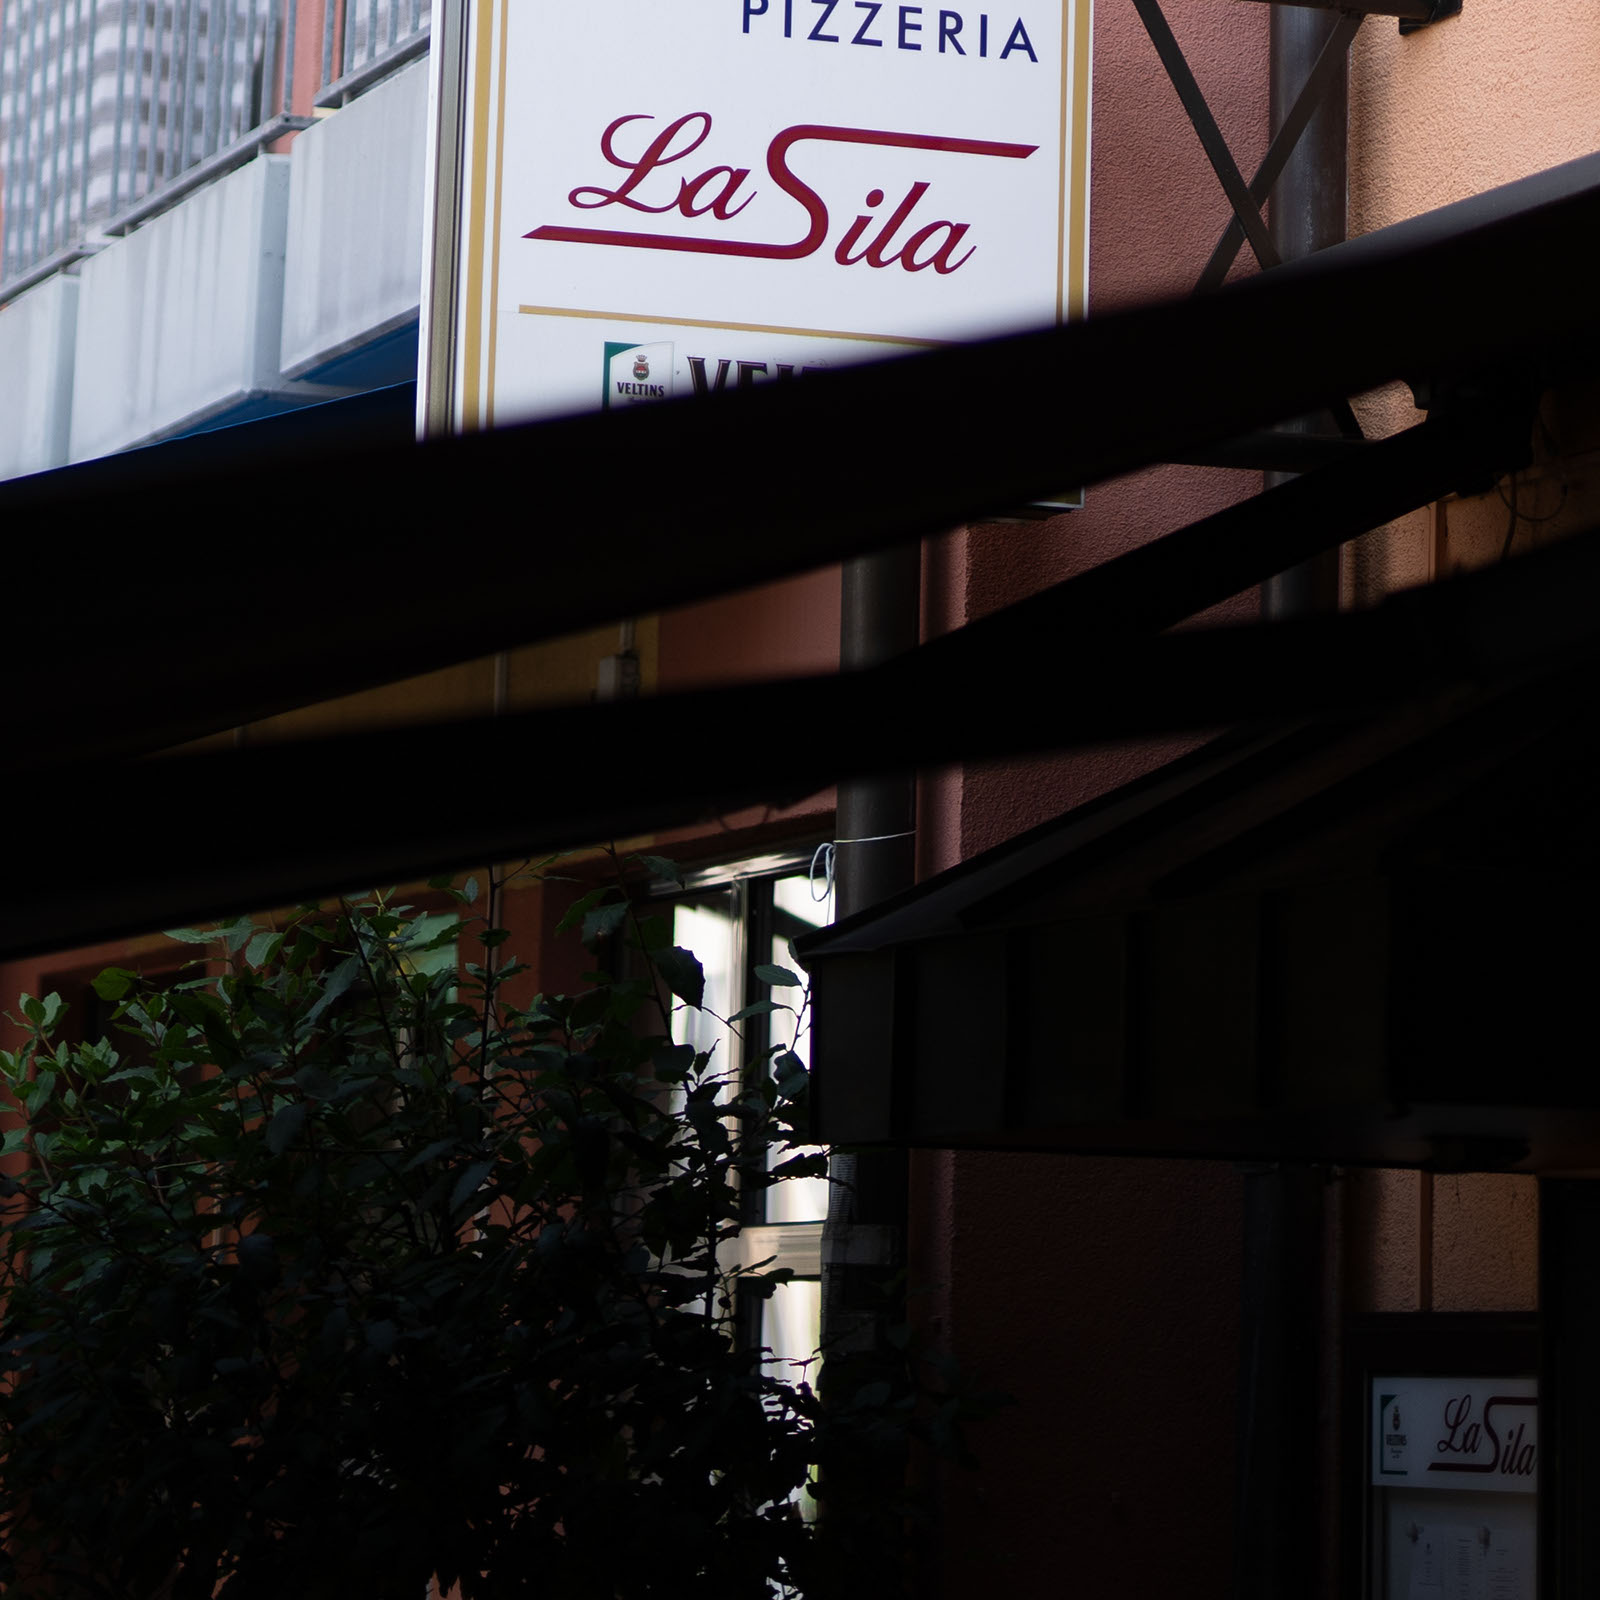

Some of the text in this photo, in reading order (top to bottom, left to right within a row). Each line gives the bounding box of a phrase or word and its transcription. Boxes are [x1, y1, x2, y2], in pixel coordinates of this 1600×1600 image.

[521, 111, 1041, 275] La Sila
[616, 381, 665, 398] VELTINS
[1427, 1394, 1539, 1476] La Sila
